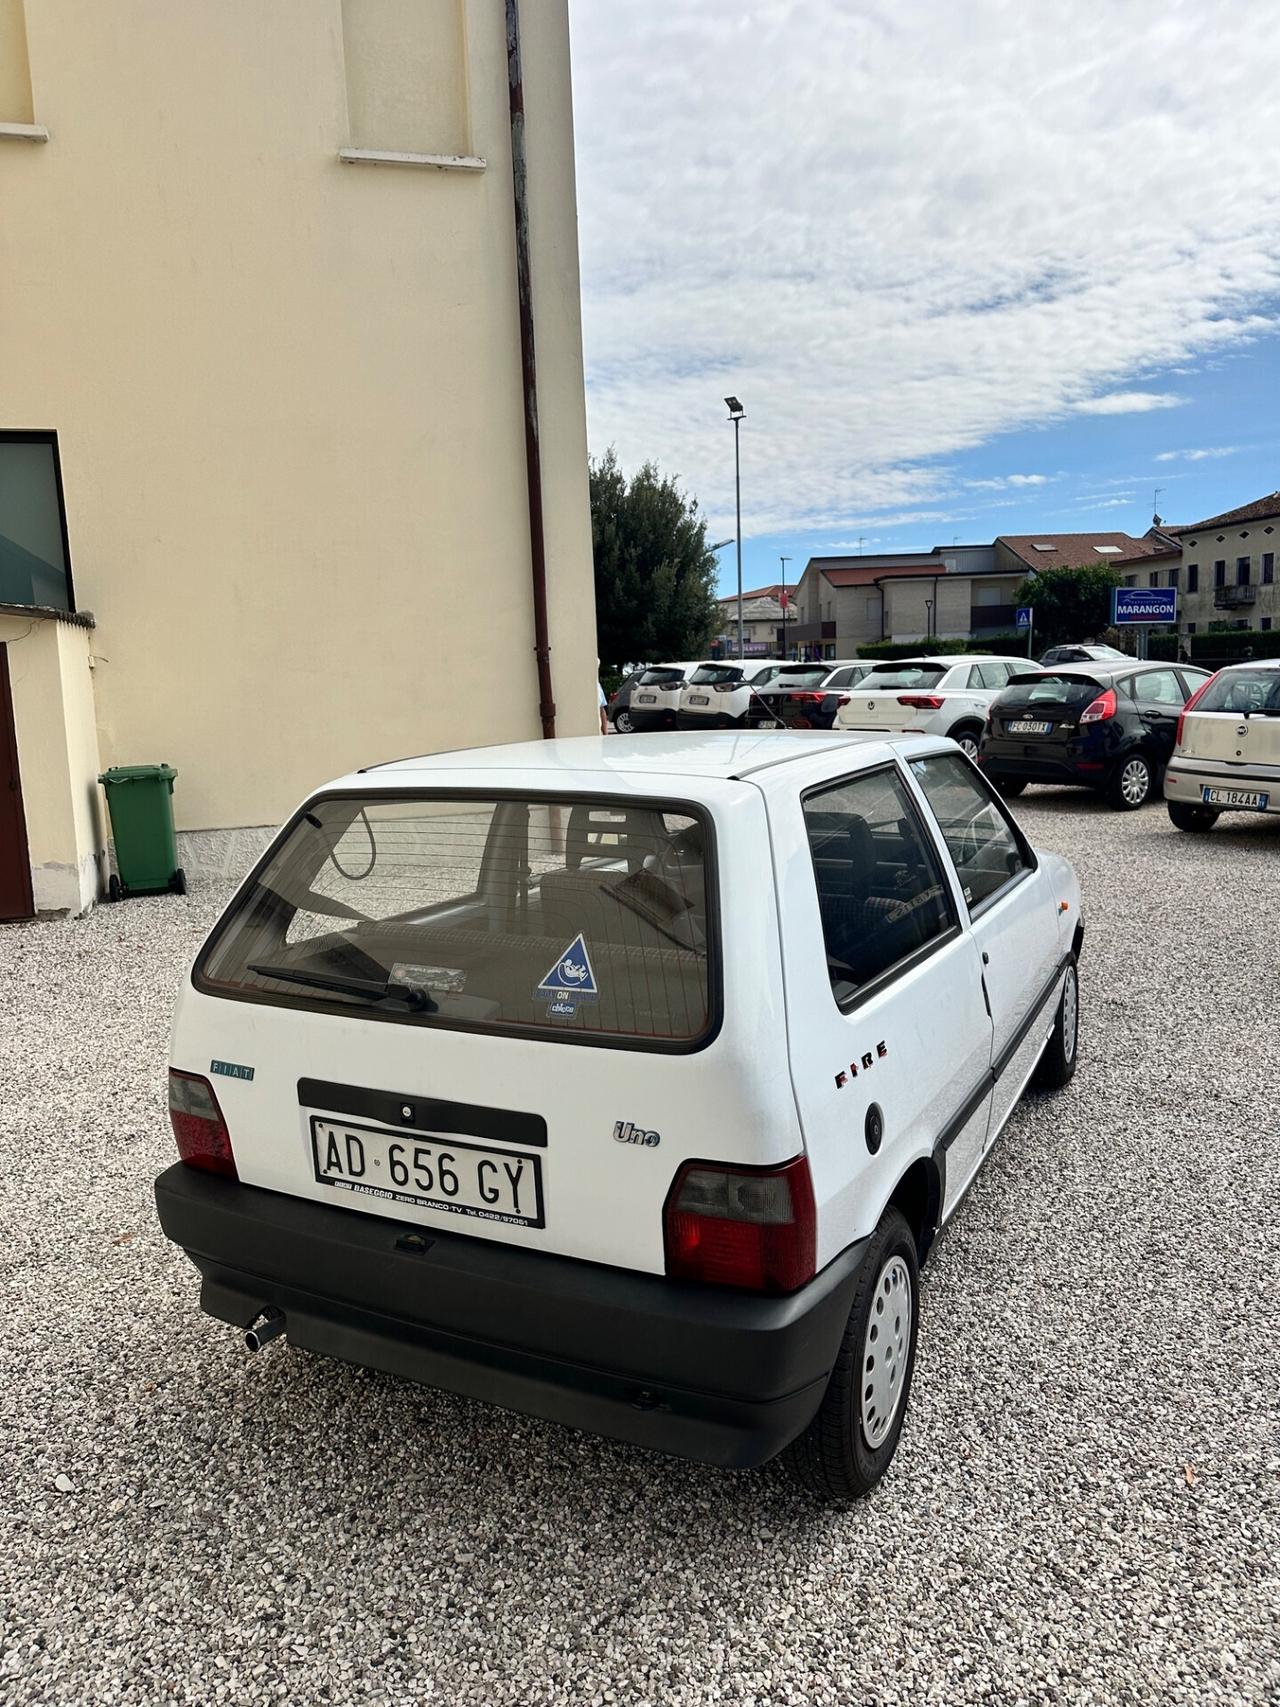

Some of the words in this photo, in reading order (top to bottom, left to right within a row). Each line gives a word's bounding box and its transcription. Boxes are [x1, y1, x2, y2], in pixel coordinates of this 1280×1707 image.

[1117, 605, 1173, 614] MARANGON
[1210, 790, 1221, 802] CL
[1226, 792, 1257, 806] 184AA
[556, 991, 569, 1000] ON
[212, 1062, 250, 1079] FIAT
[834, 1040, 887, 1089] FIRE
[613, 1120, 661, 1147] Uno
[326, 1130, 366, 1177] AD
[388, 1143, 459, 1197] 656
[477, 1159, 524, 1209] GY
[353, 1184, 393, 1199] BASEGGIO
[395, 1194, 416, 1203] ZERO
